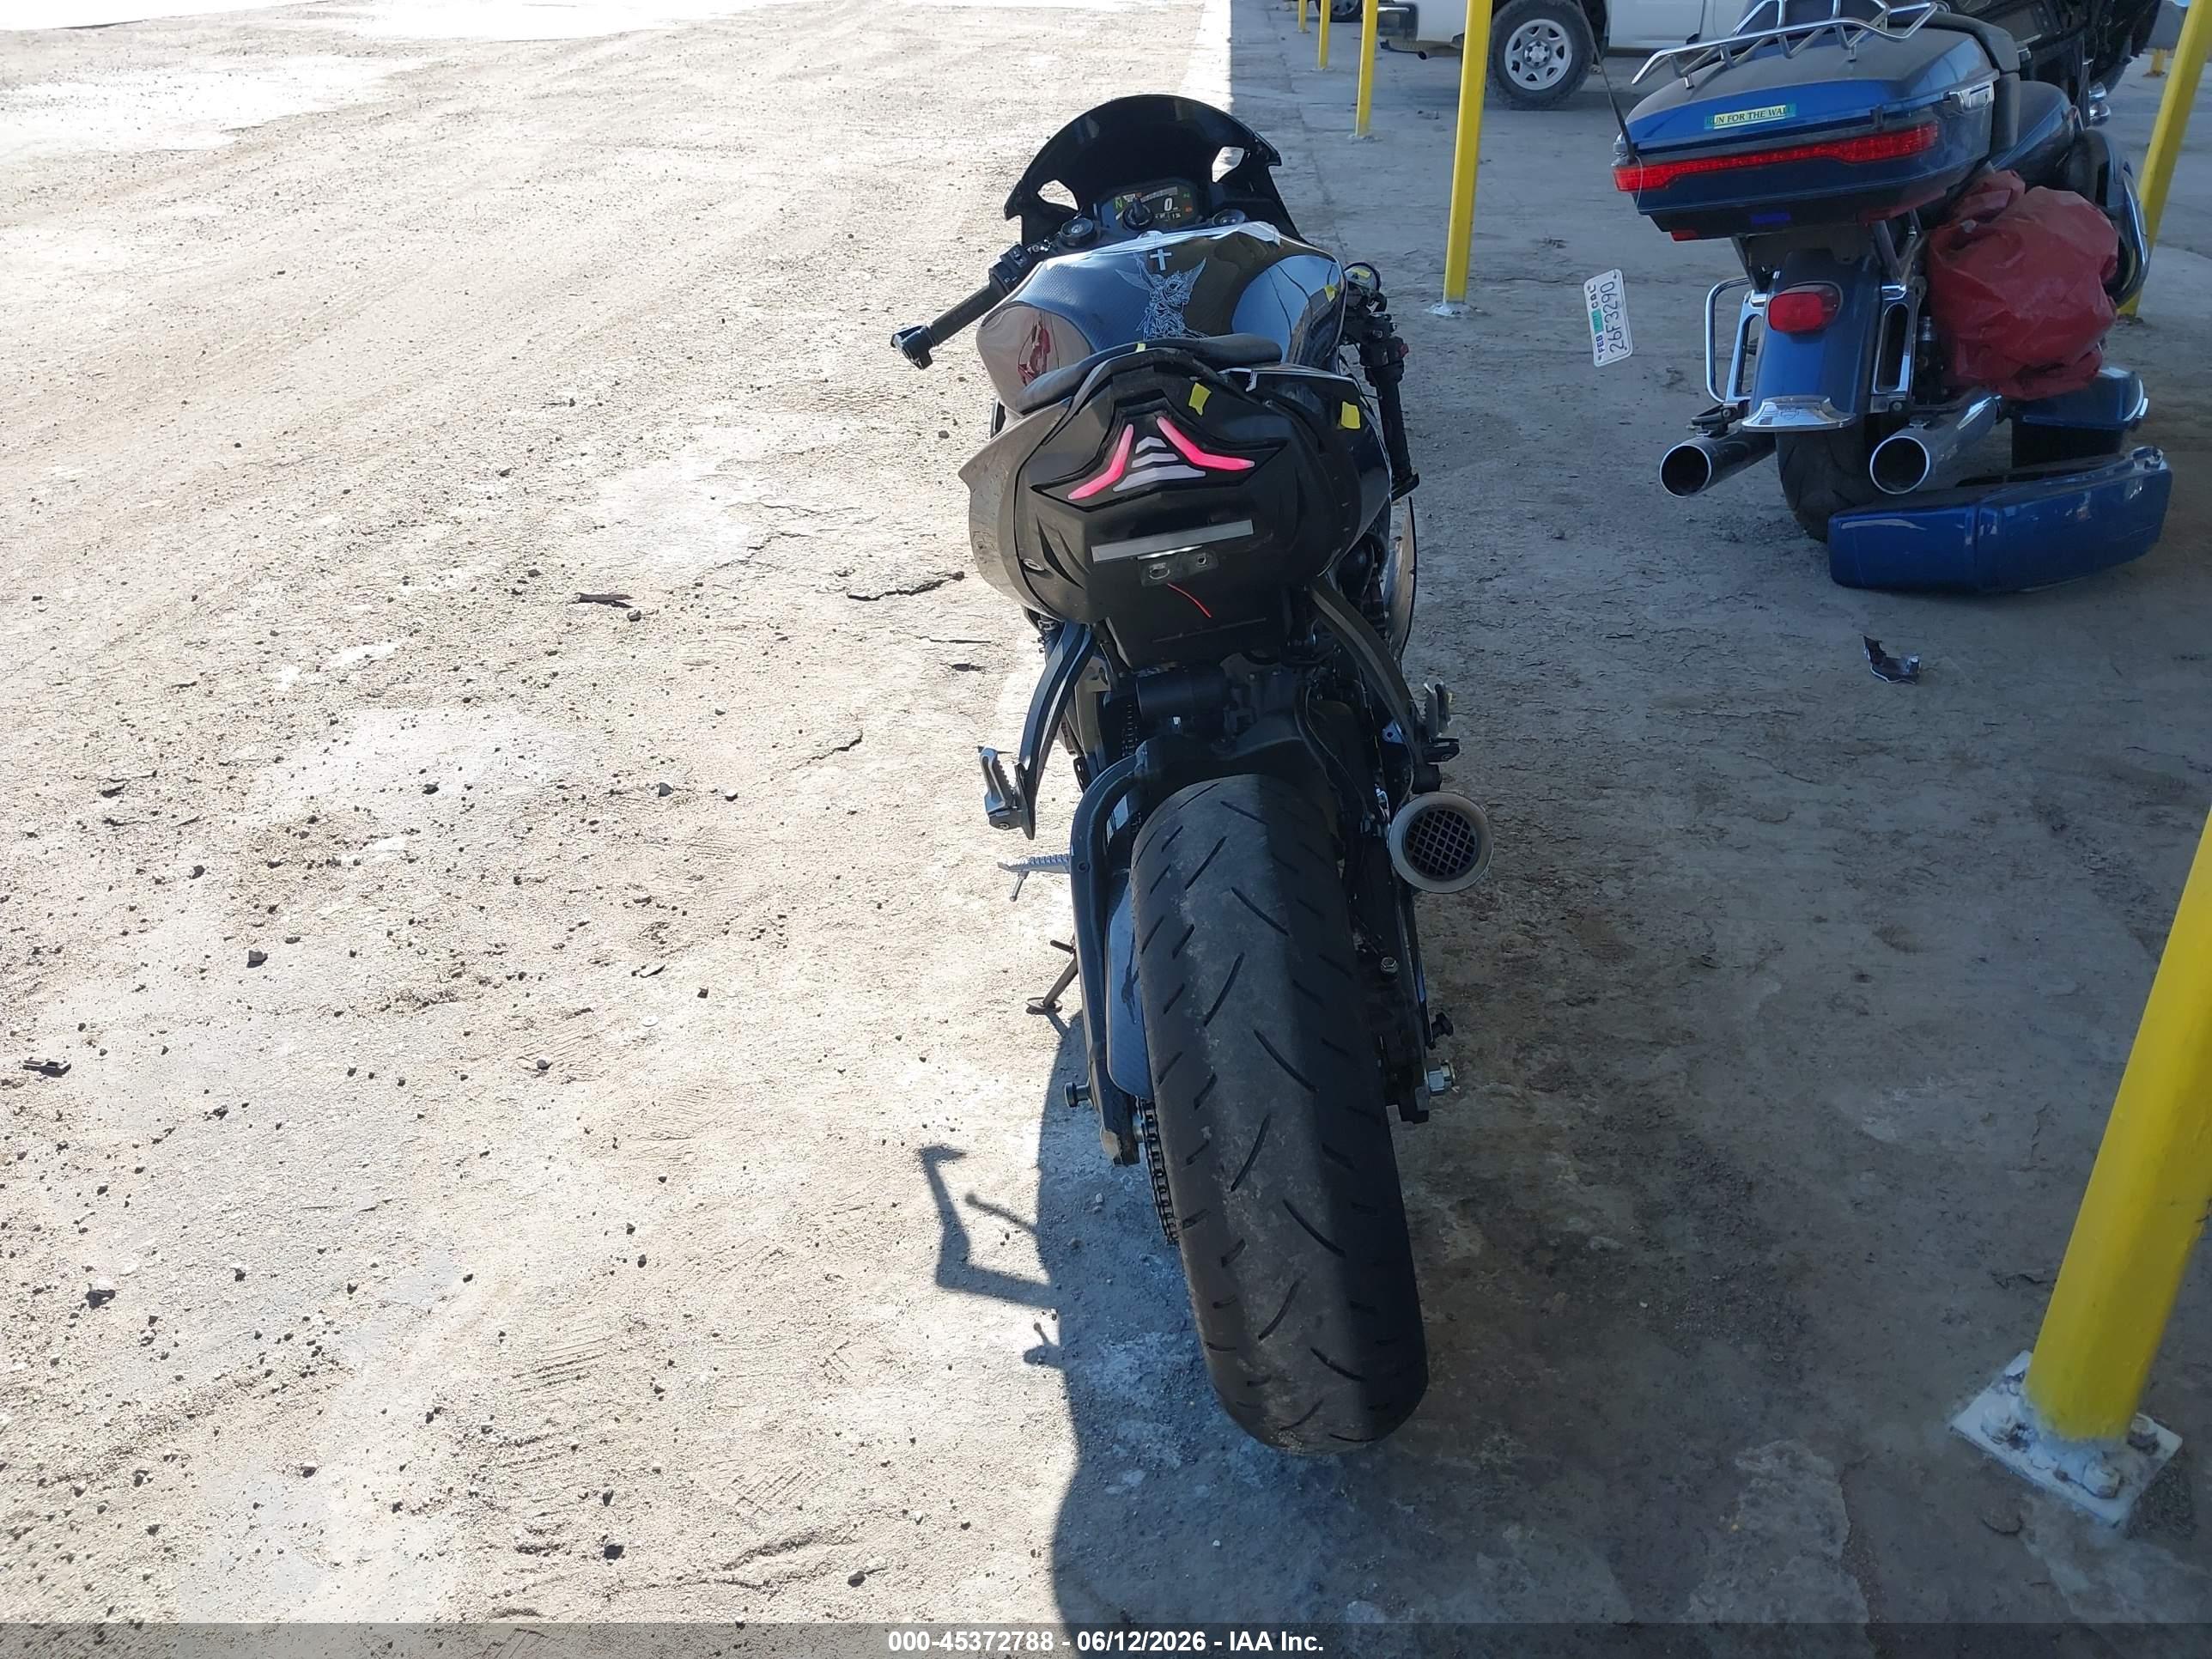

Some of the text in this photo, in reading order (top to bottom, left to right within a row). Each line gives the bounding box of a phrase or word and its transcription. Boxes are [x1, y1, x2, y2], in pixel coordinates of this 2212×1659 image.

[1727, 112, 1746, 124] FOR
[1747, 109, 1766, 120] THE
[1164, 198, 1173, 211] 0
[1600, 281, 1624, 353] 26F3290
[1595, 335, 1605, 353] FEB
